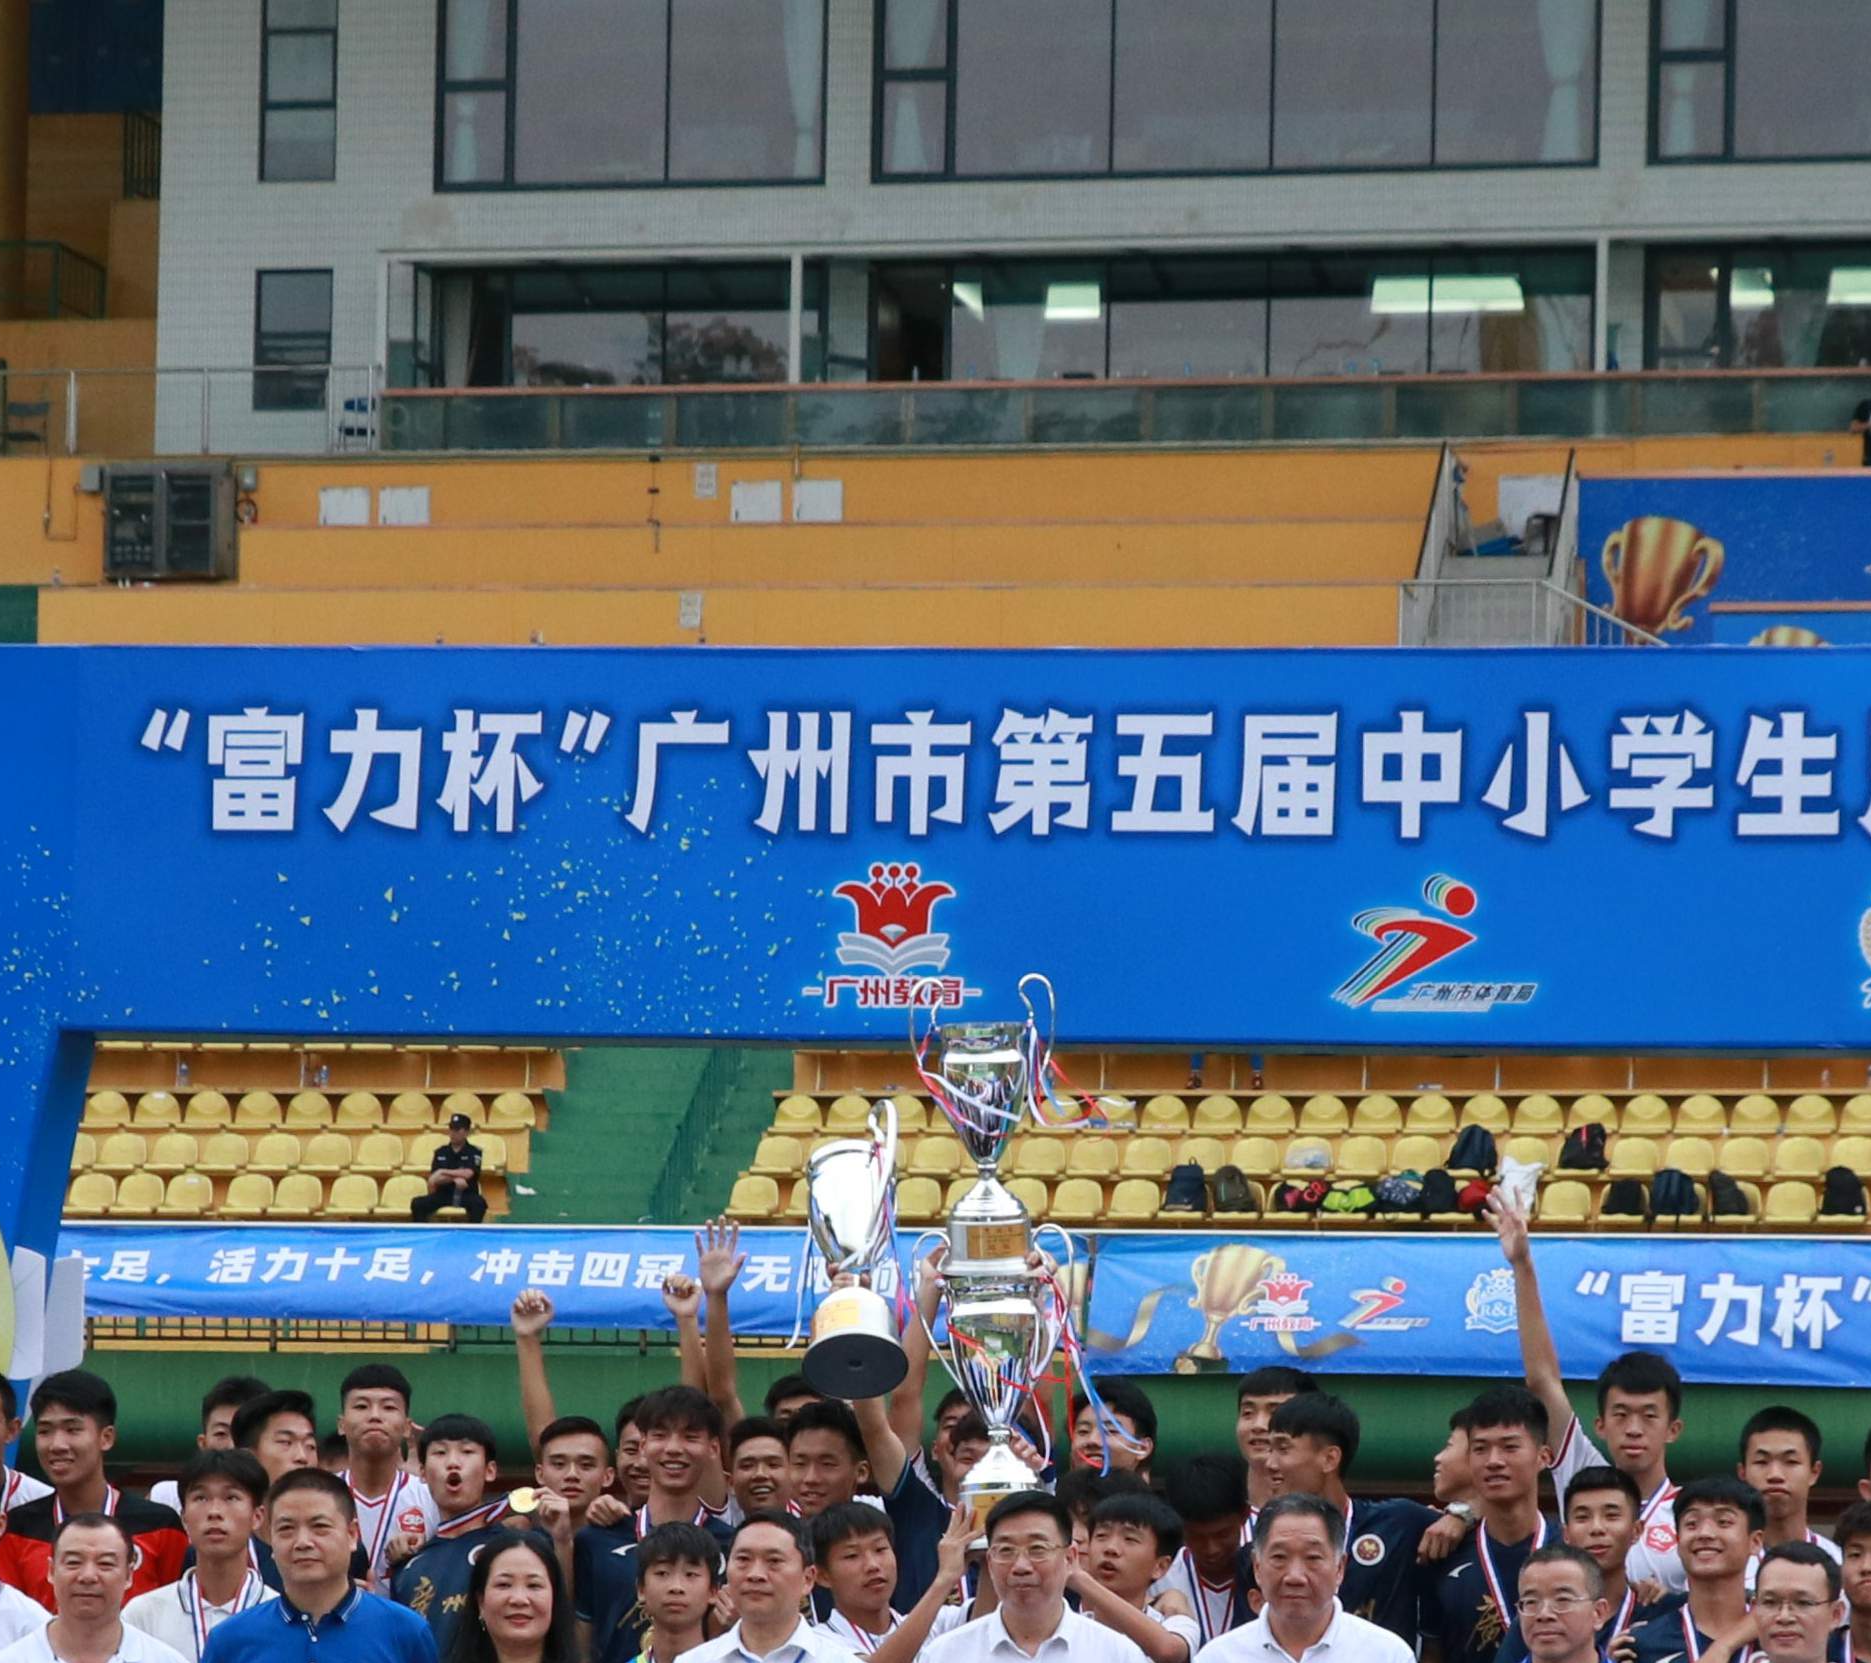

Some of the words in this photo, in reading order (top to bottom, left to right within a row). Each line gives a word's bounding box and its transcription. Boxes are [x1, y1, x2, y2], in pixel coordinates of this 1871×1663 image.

[825, 976, 964, 1008] 广州教育
[1413, 982, 1537, 1003] 广州市体育局
